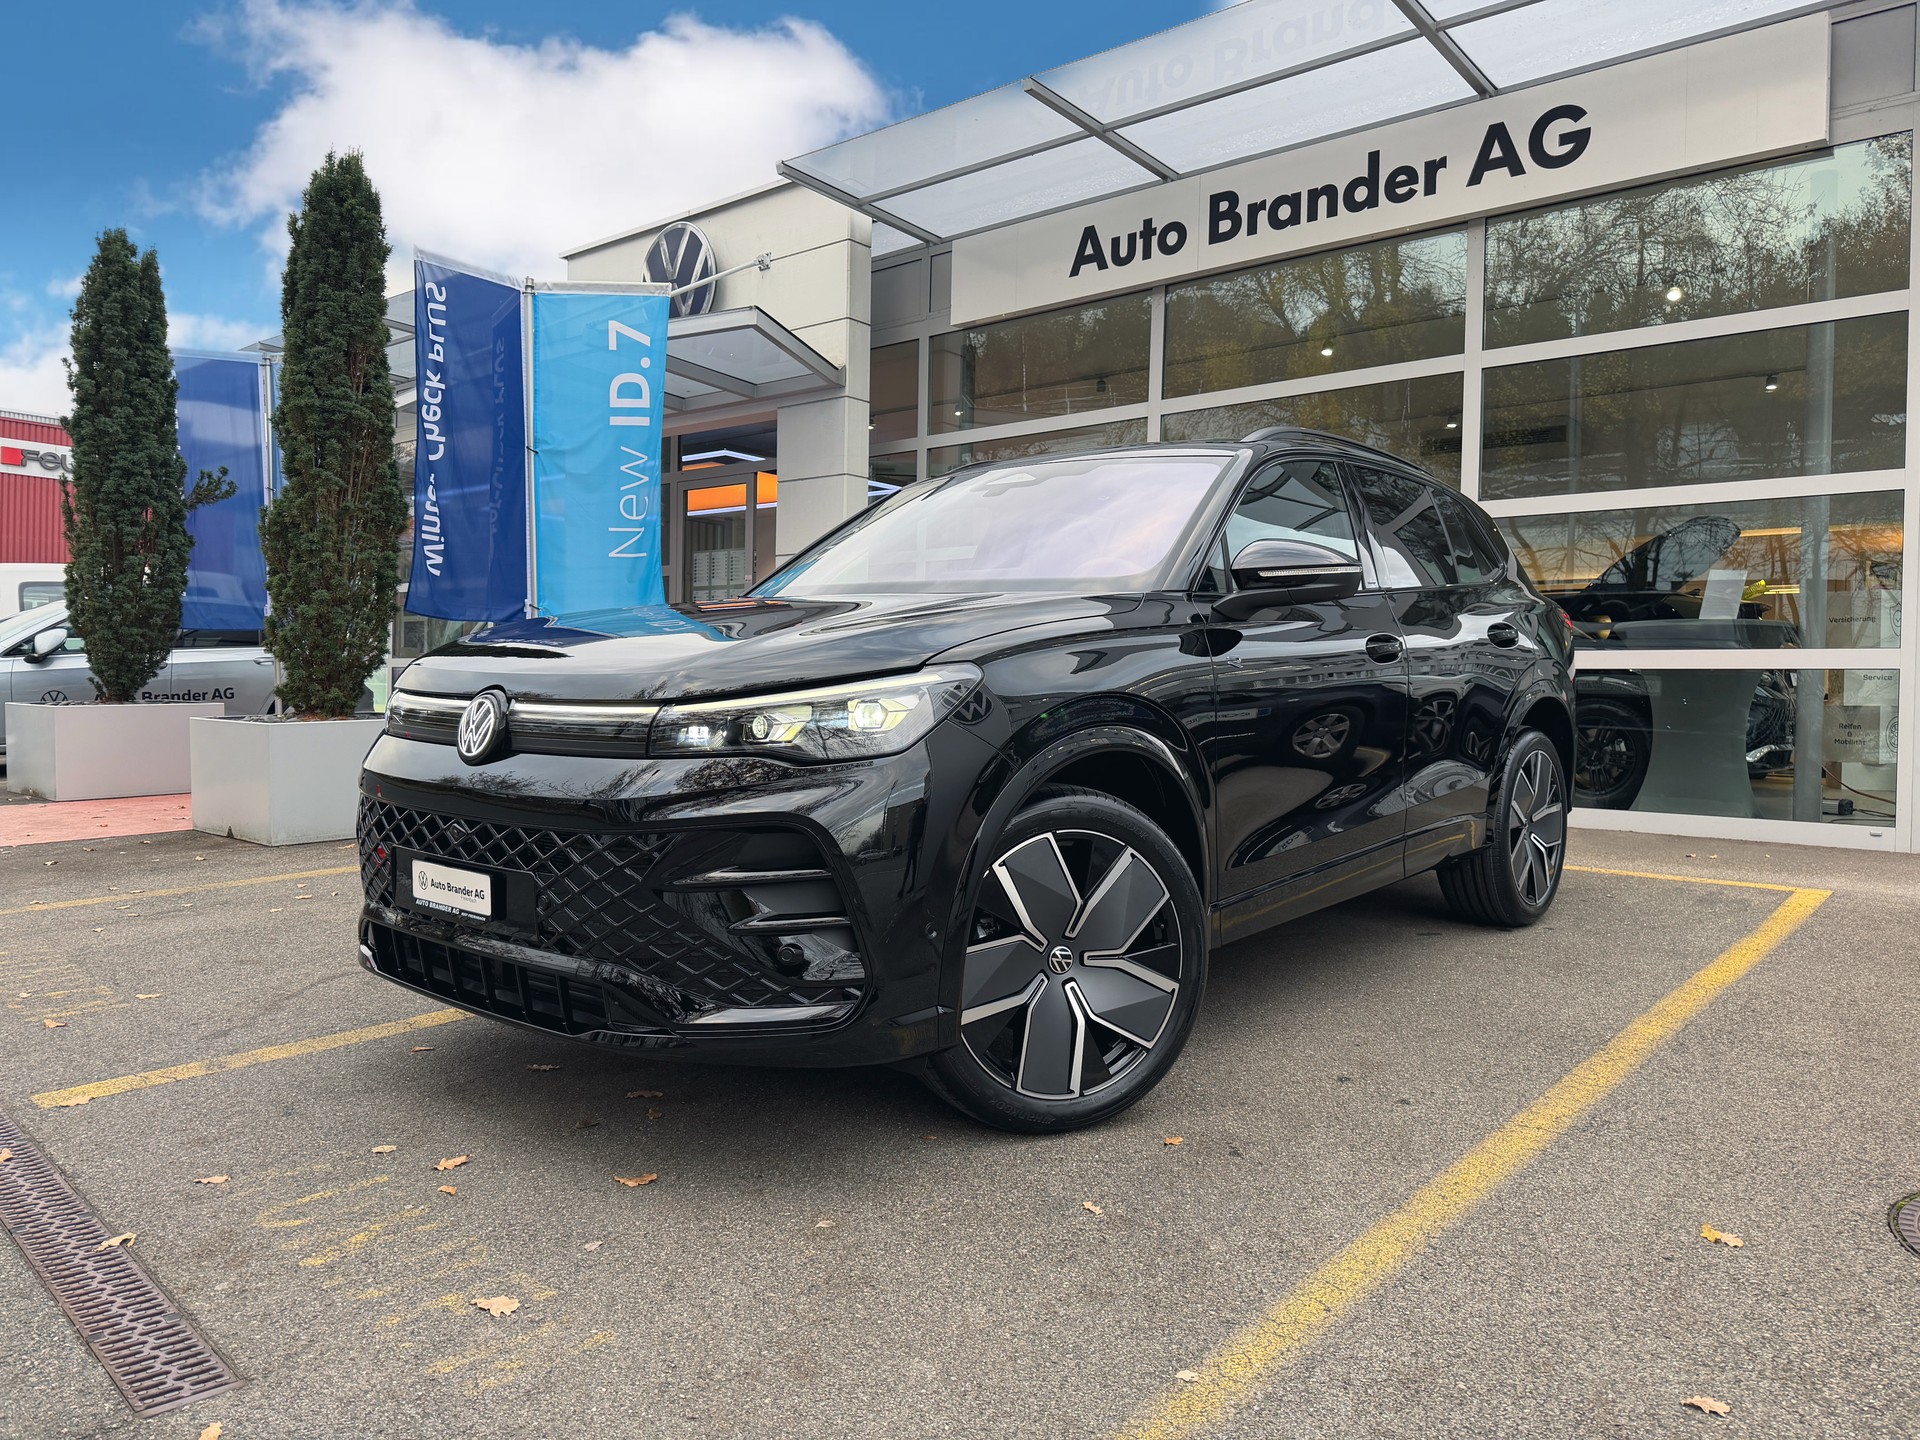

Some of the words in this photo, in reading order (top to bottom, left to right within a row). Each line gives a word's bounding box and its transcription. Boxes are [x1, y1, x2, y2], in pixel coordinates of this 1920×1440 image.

[1068, 216, 1188, 278] Auto
[1207, 149, 1448, 246] Brander
[1465, 103, 1592, 188] AG
[608, 319, 652, 427] ID.7
[608, 445, 650, 558] New
[1828, 615, 1877, 624] Versicherung
[1862, 673, 1893, 681] Service
[211, 687, 235, 700] AG
[1838, 722, 1862, 730] Reifen
[430, 878, 446, 891] Auto
[447, 882, 474, 898] Brander
[474, 888, 485, 900] AG
[415, 898, 429, 907] AUTO
[429, 901, 452, 912] BRANDER
[452, 907, 460, 915] AG
